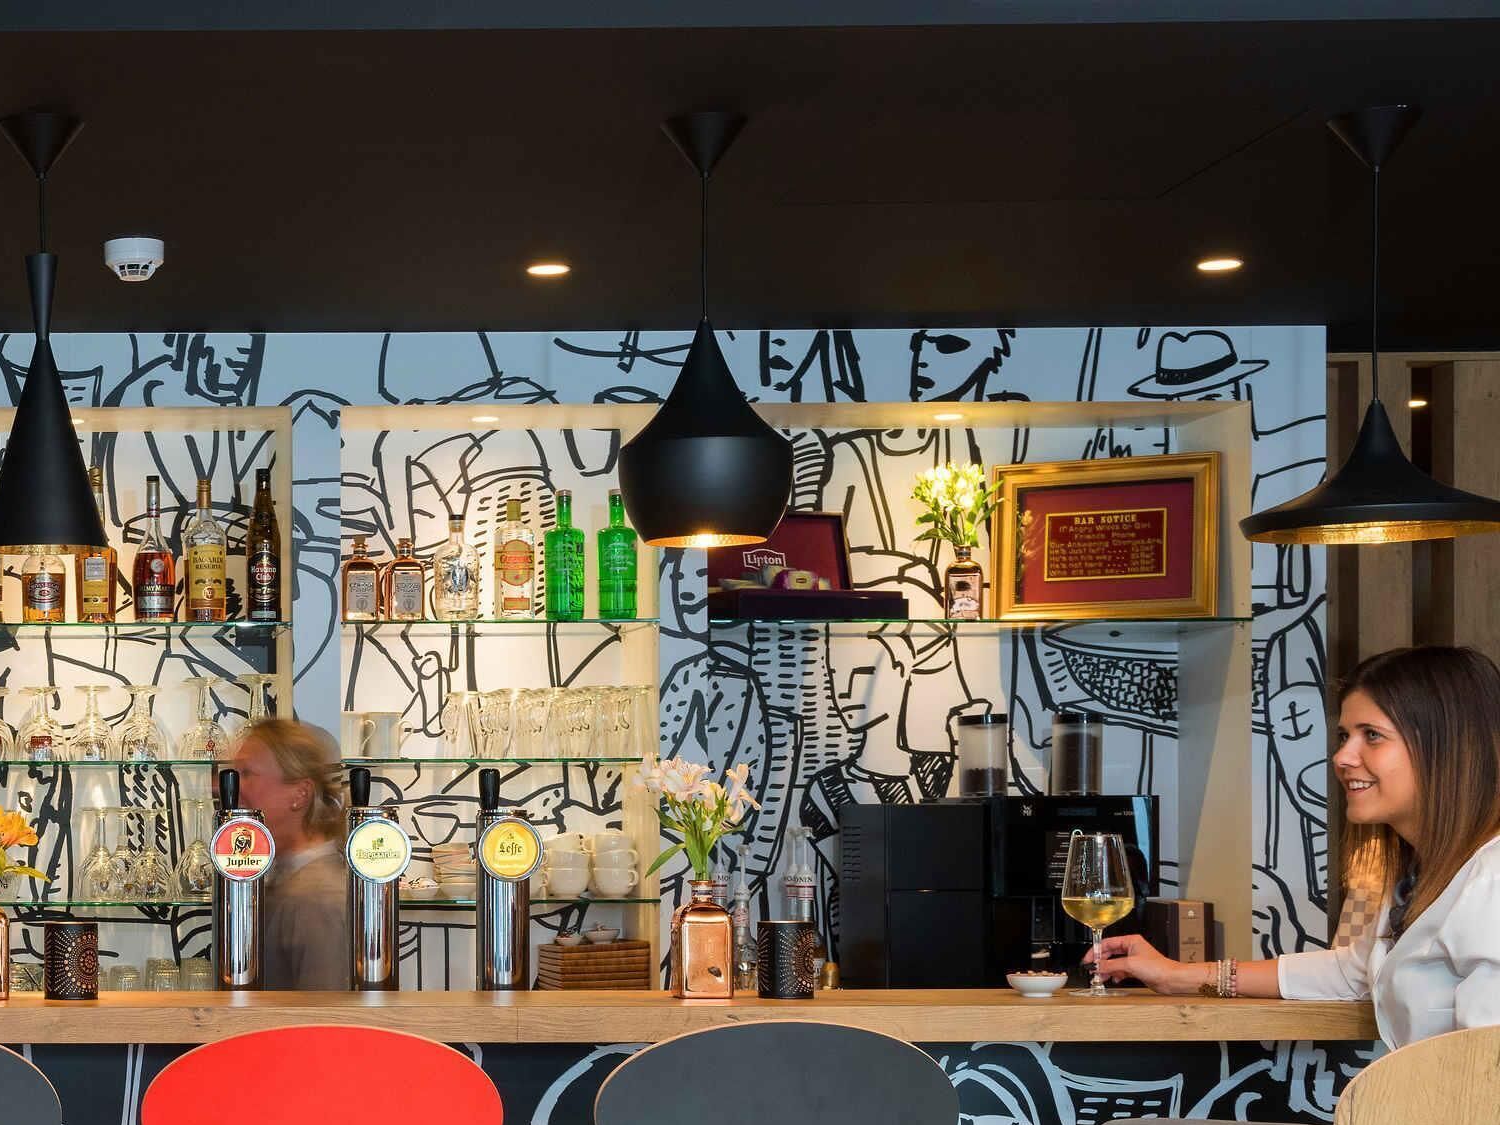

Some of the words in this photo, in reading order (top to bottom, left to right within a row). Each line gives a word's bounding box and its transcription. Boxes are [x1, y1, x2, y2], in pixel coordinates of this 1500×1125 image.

[747, 554, 783, 567] Lipton
[251, 565, 277, 573] Havana
[255, 573, 272, 581] Club
[499, 841, 523, 856] Leffe
[225, 857, 262, 867] Jupiler
